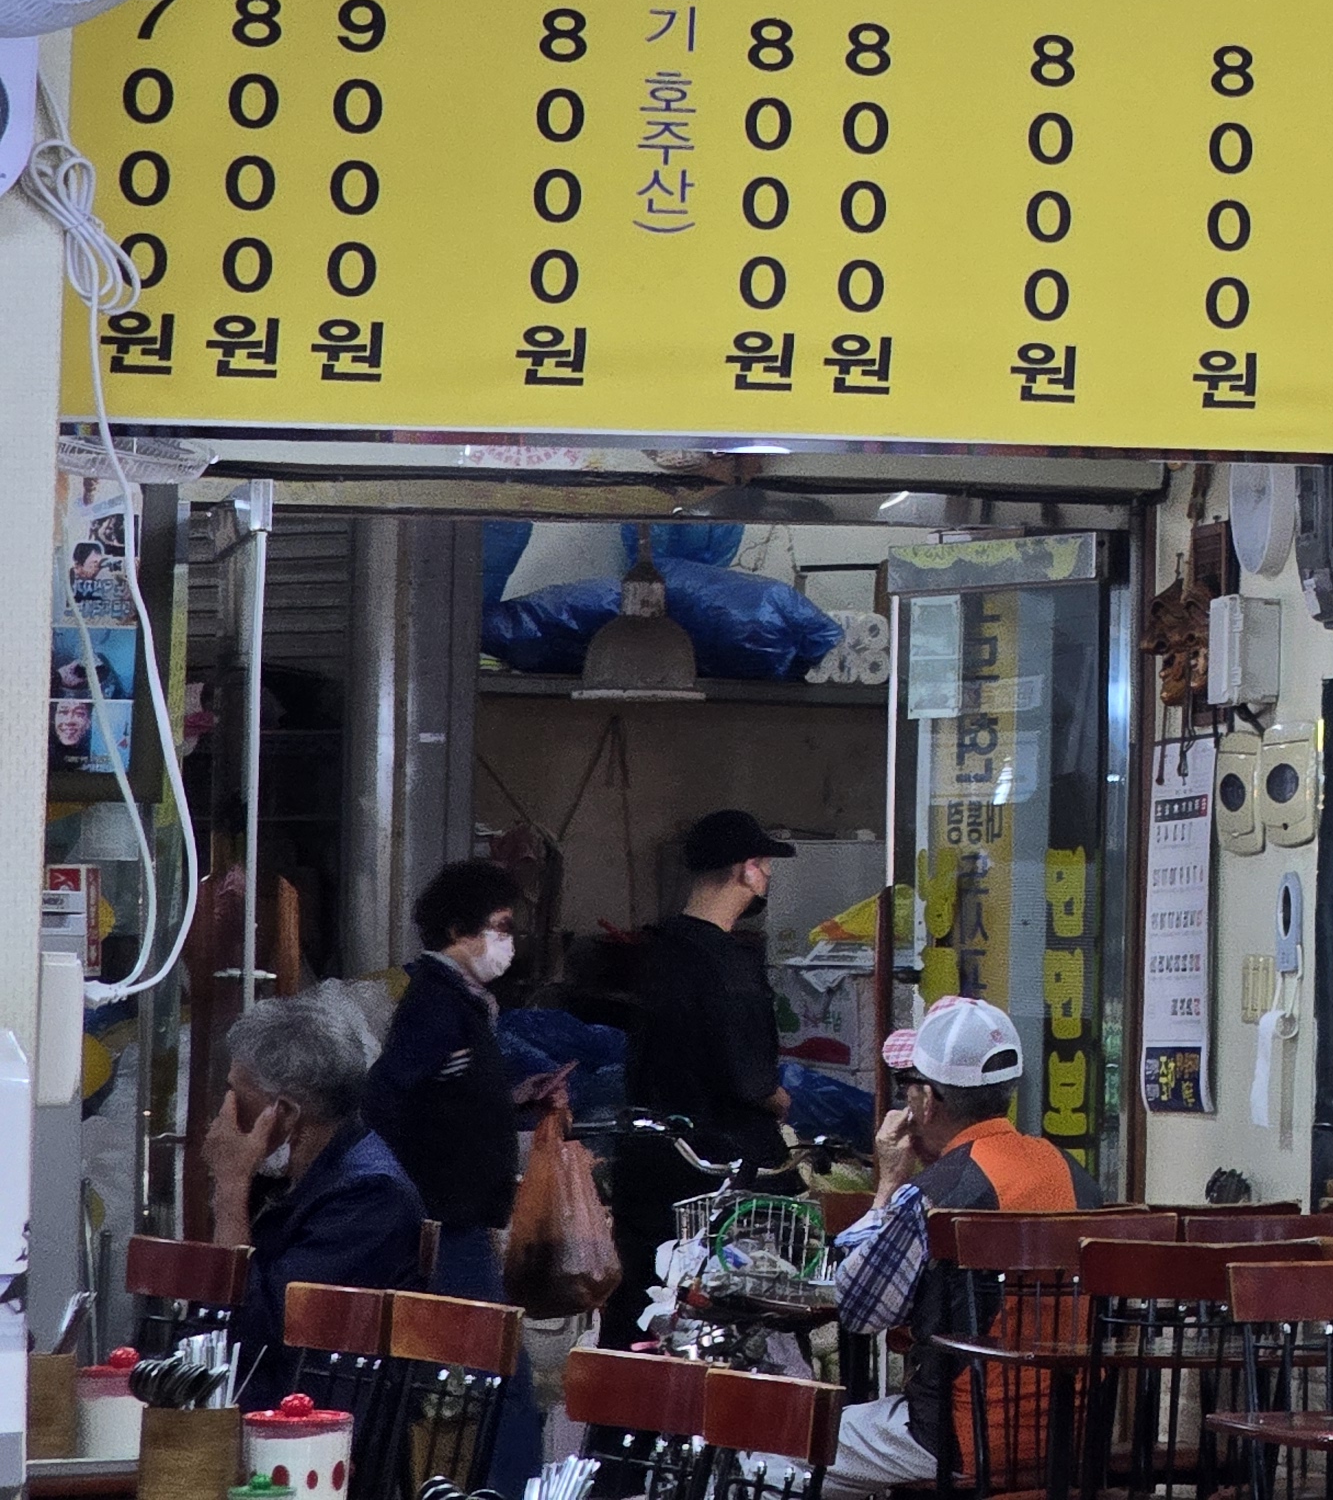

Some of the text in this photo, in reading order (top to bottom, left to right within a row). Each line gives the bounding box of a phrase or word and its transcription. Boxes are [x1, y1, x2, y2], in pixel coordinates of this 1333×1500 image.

[516, 8, 587, 386] 8000원
[634, 72, 696, 233] 호주산)
[725, 18, 794, 391] 8000원
[823, 23, 892, 395] 8000원
[1010, 34, 1076, 403] 8000원
[1193, 45, 1257, 409] 8000원
